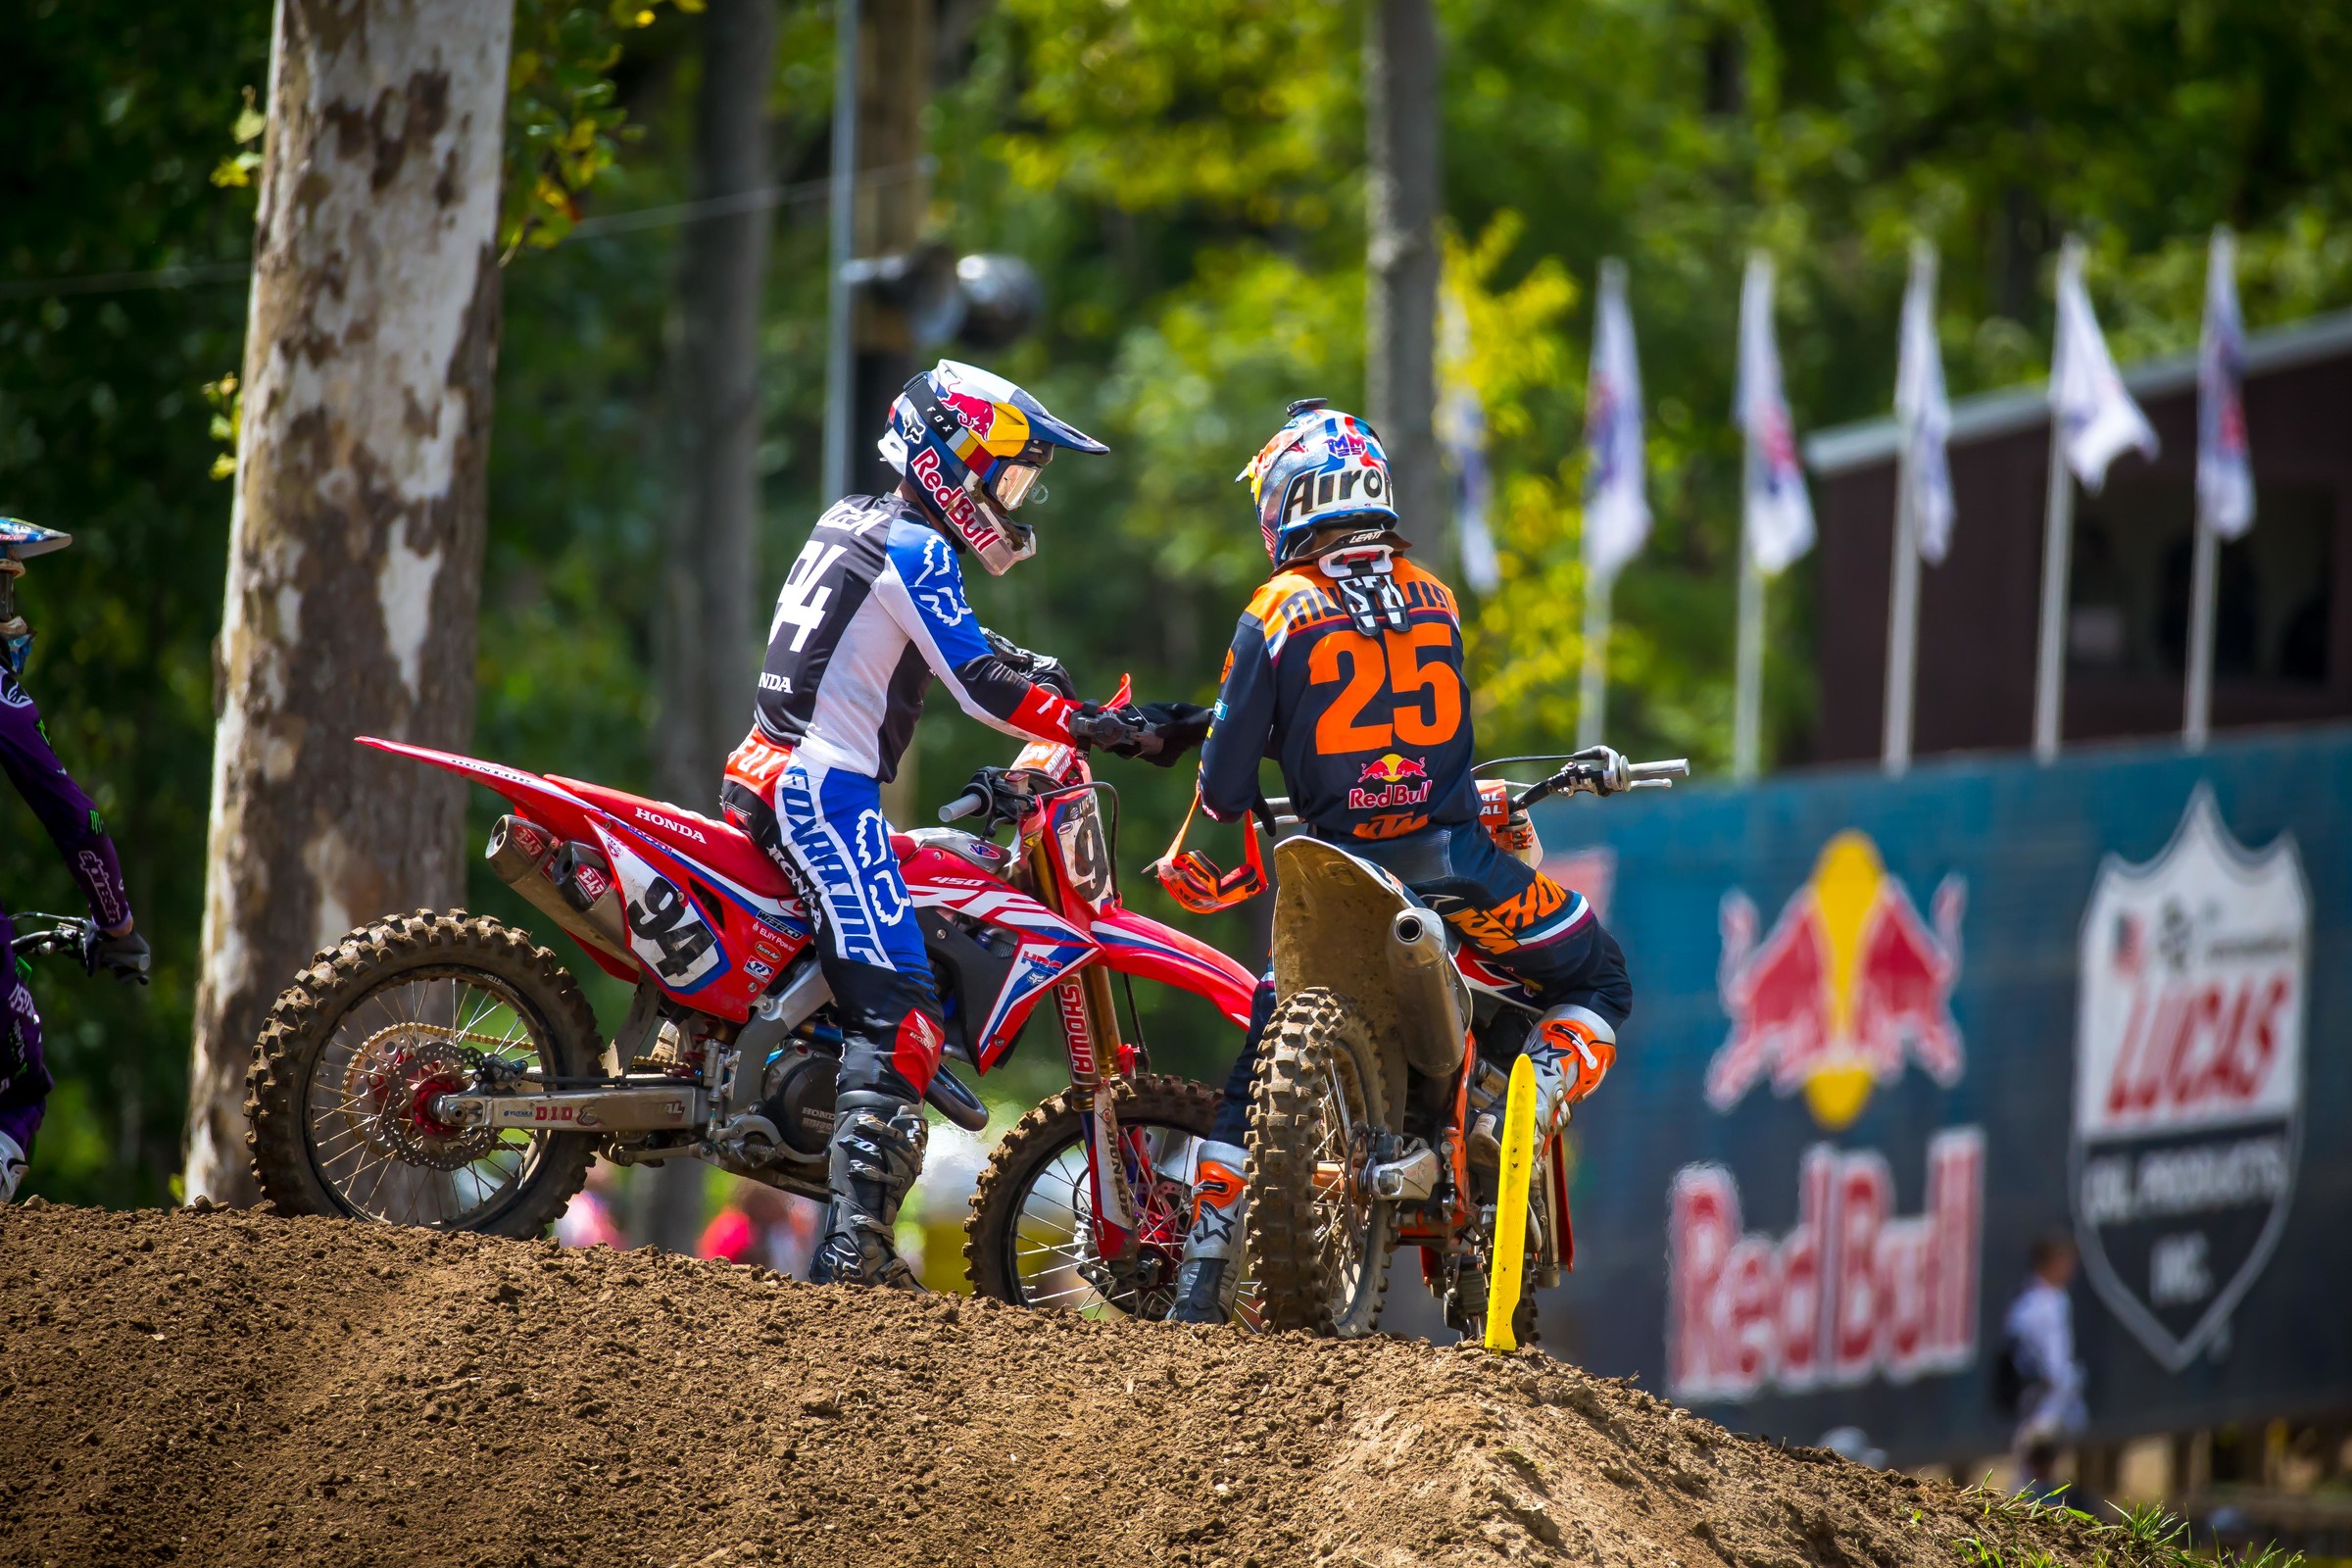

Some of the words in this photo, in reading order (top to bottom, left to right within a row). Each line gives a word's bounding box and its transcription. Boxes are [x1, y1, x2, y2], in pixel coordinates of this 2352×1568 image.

[926, 406, 954, 433] FOX
[1348, 530, 1385, 544] LEATT
[758, 671, 794, 695] NDA
[1307, 621, 1462, 756] 25
[729, 738, 789, 781] FOX
[634, 807, 708, 845] HONDA
[1352, 811, 1429, 840] KTM
[627, 875, 717, 979] 94
[1446, 906, 1520, 955] KTM
[756, 943, 771, 956] Twin
[769, 951, 780, 959] Air
[1020, 951, 1063, 976] HRC
[1058, 984, 1097, 1074] SHOWA
[2101, 970, 2292, 1127] LUCAS
[802, 1106, 835, 1120] HOND
